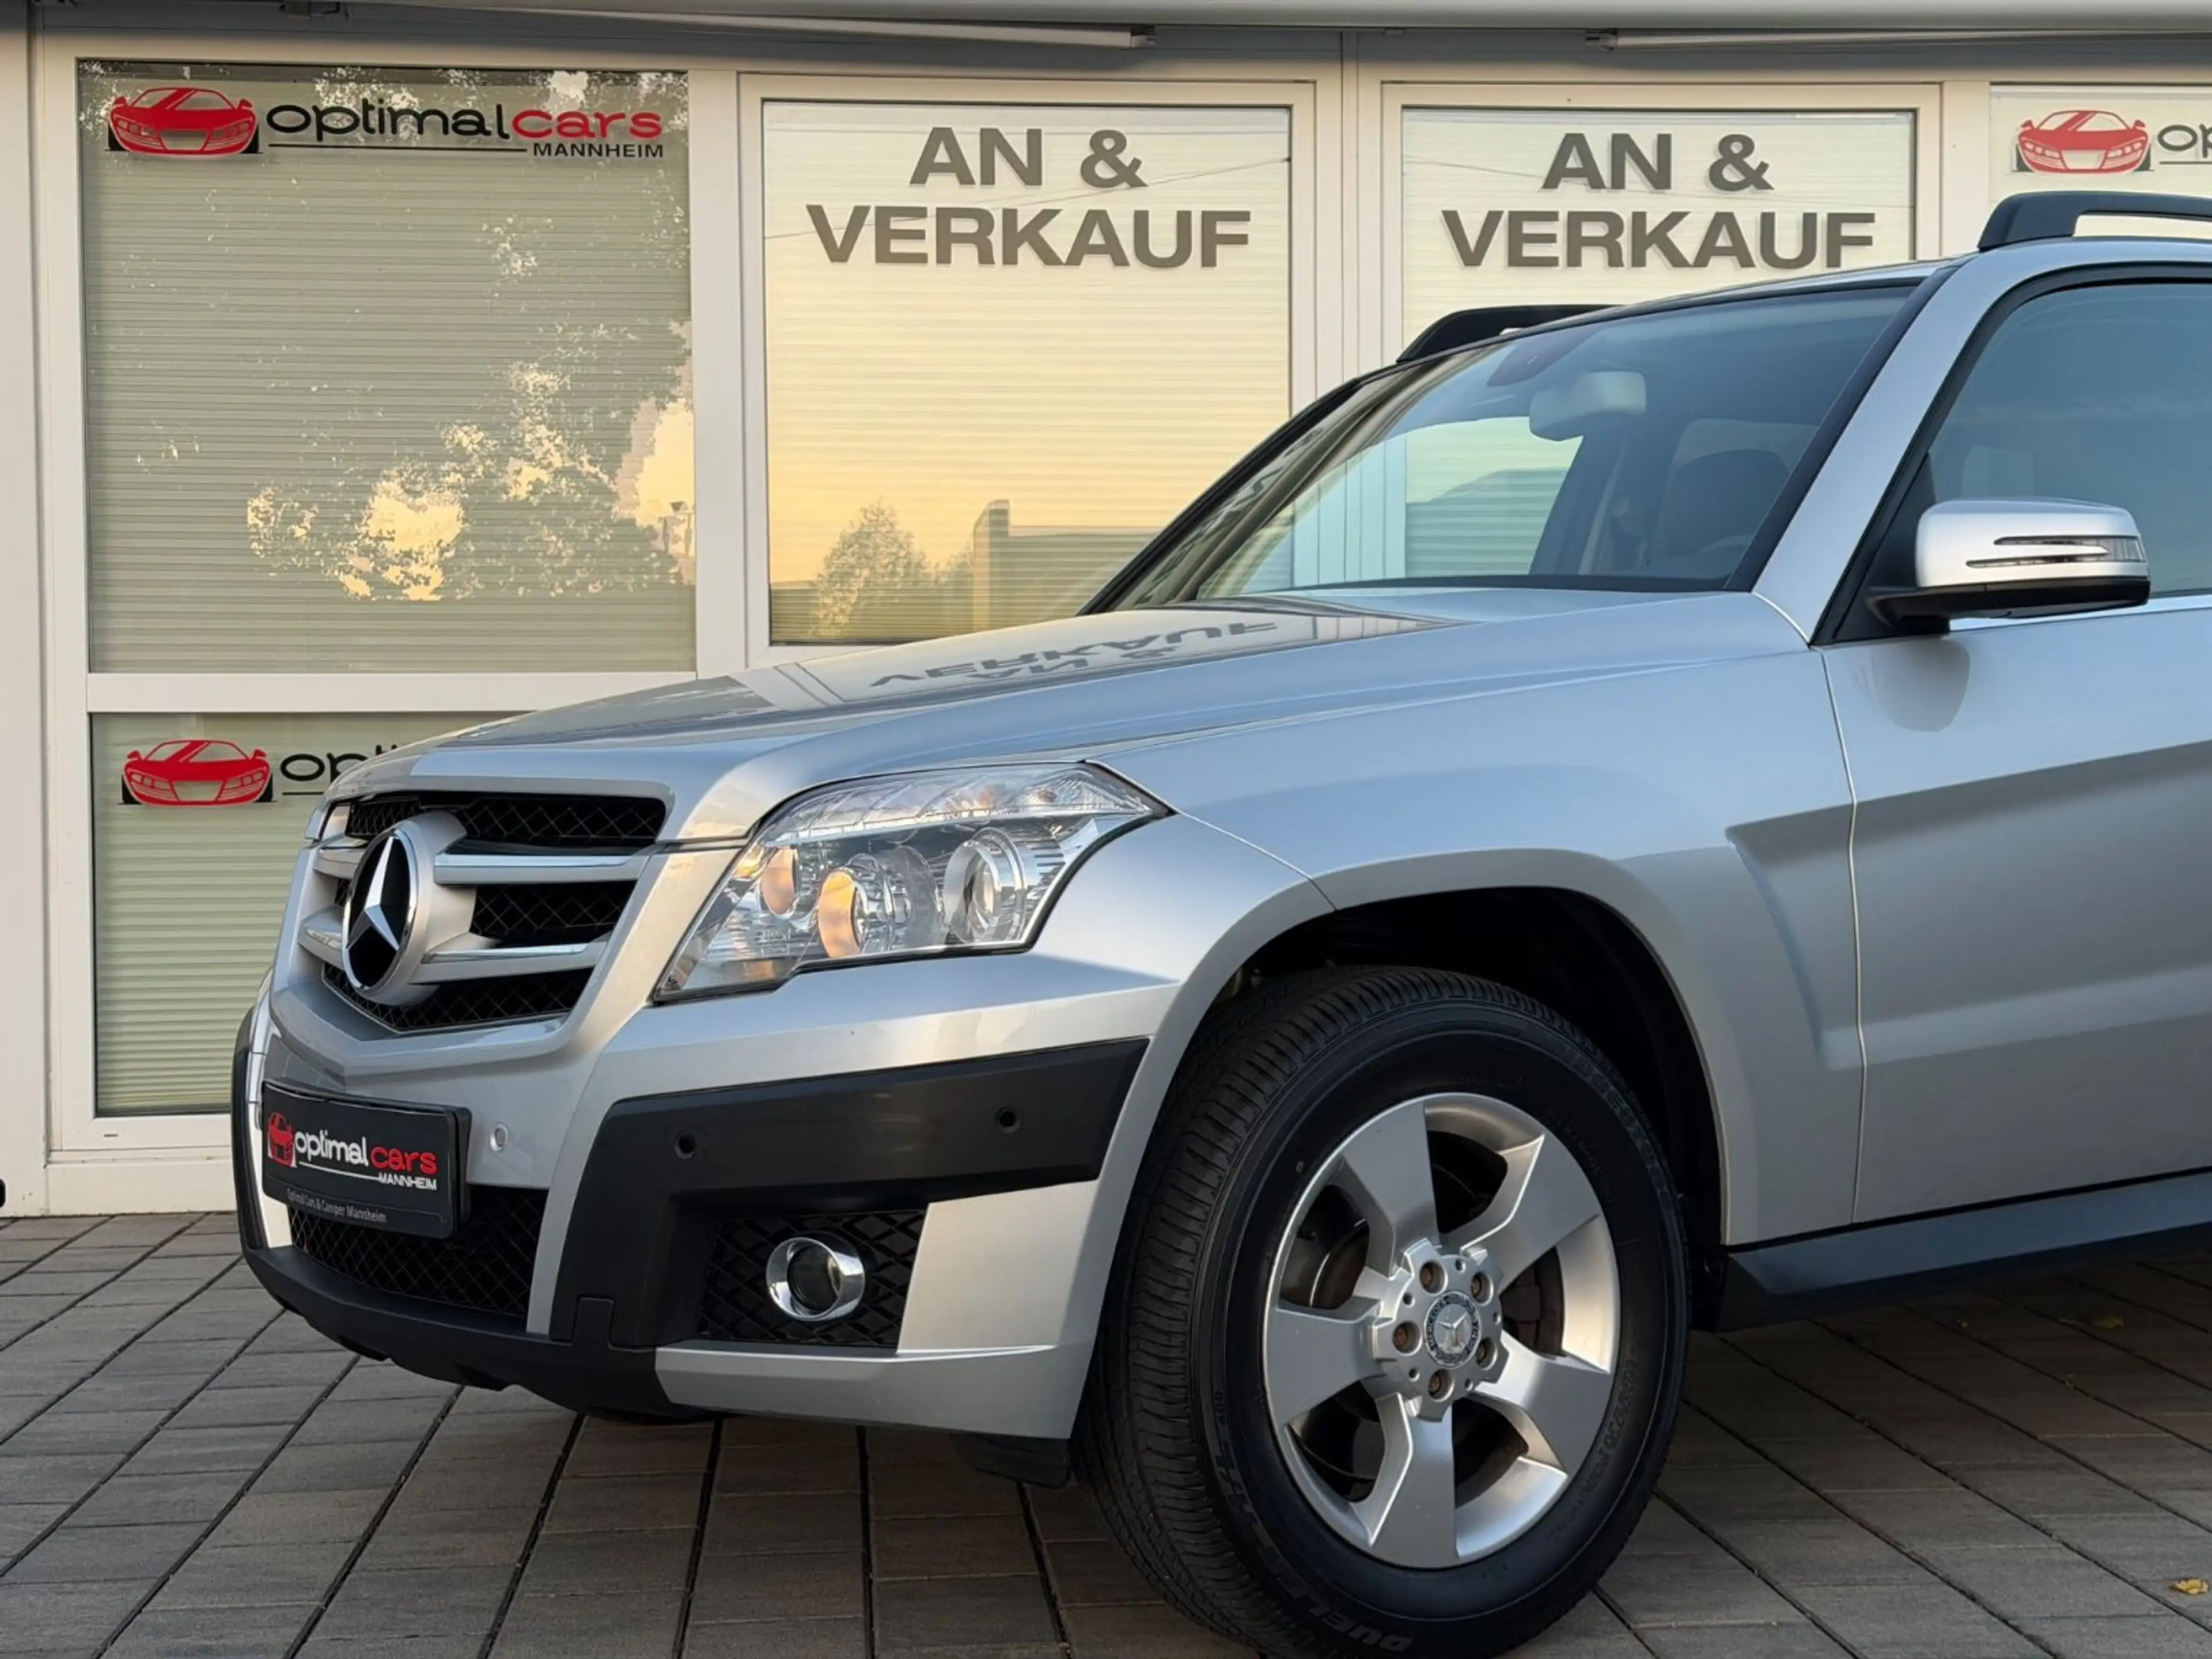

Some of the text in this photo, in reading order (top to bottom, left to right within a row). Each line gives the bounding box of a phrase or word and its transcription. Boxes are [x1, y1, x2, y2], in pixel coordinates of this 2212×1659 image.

[266, 97, 664, 142] optimalcars
[533, 142, 664, 158] MANNHEIM
[909, 127, 1149, 188] AN &
[1541, 132, 1775, 191] AN &
[806, 204, 1251, 268] VERKAUF
[1441, 209, 1876, 268] VERKAUF
[378, 1172, 437, 1191] MANNHEIM
